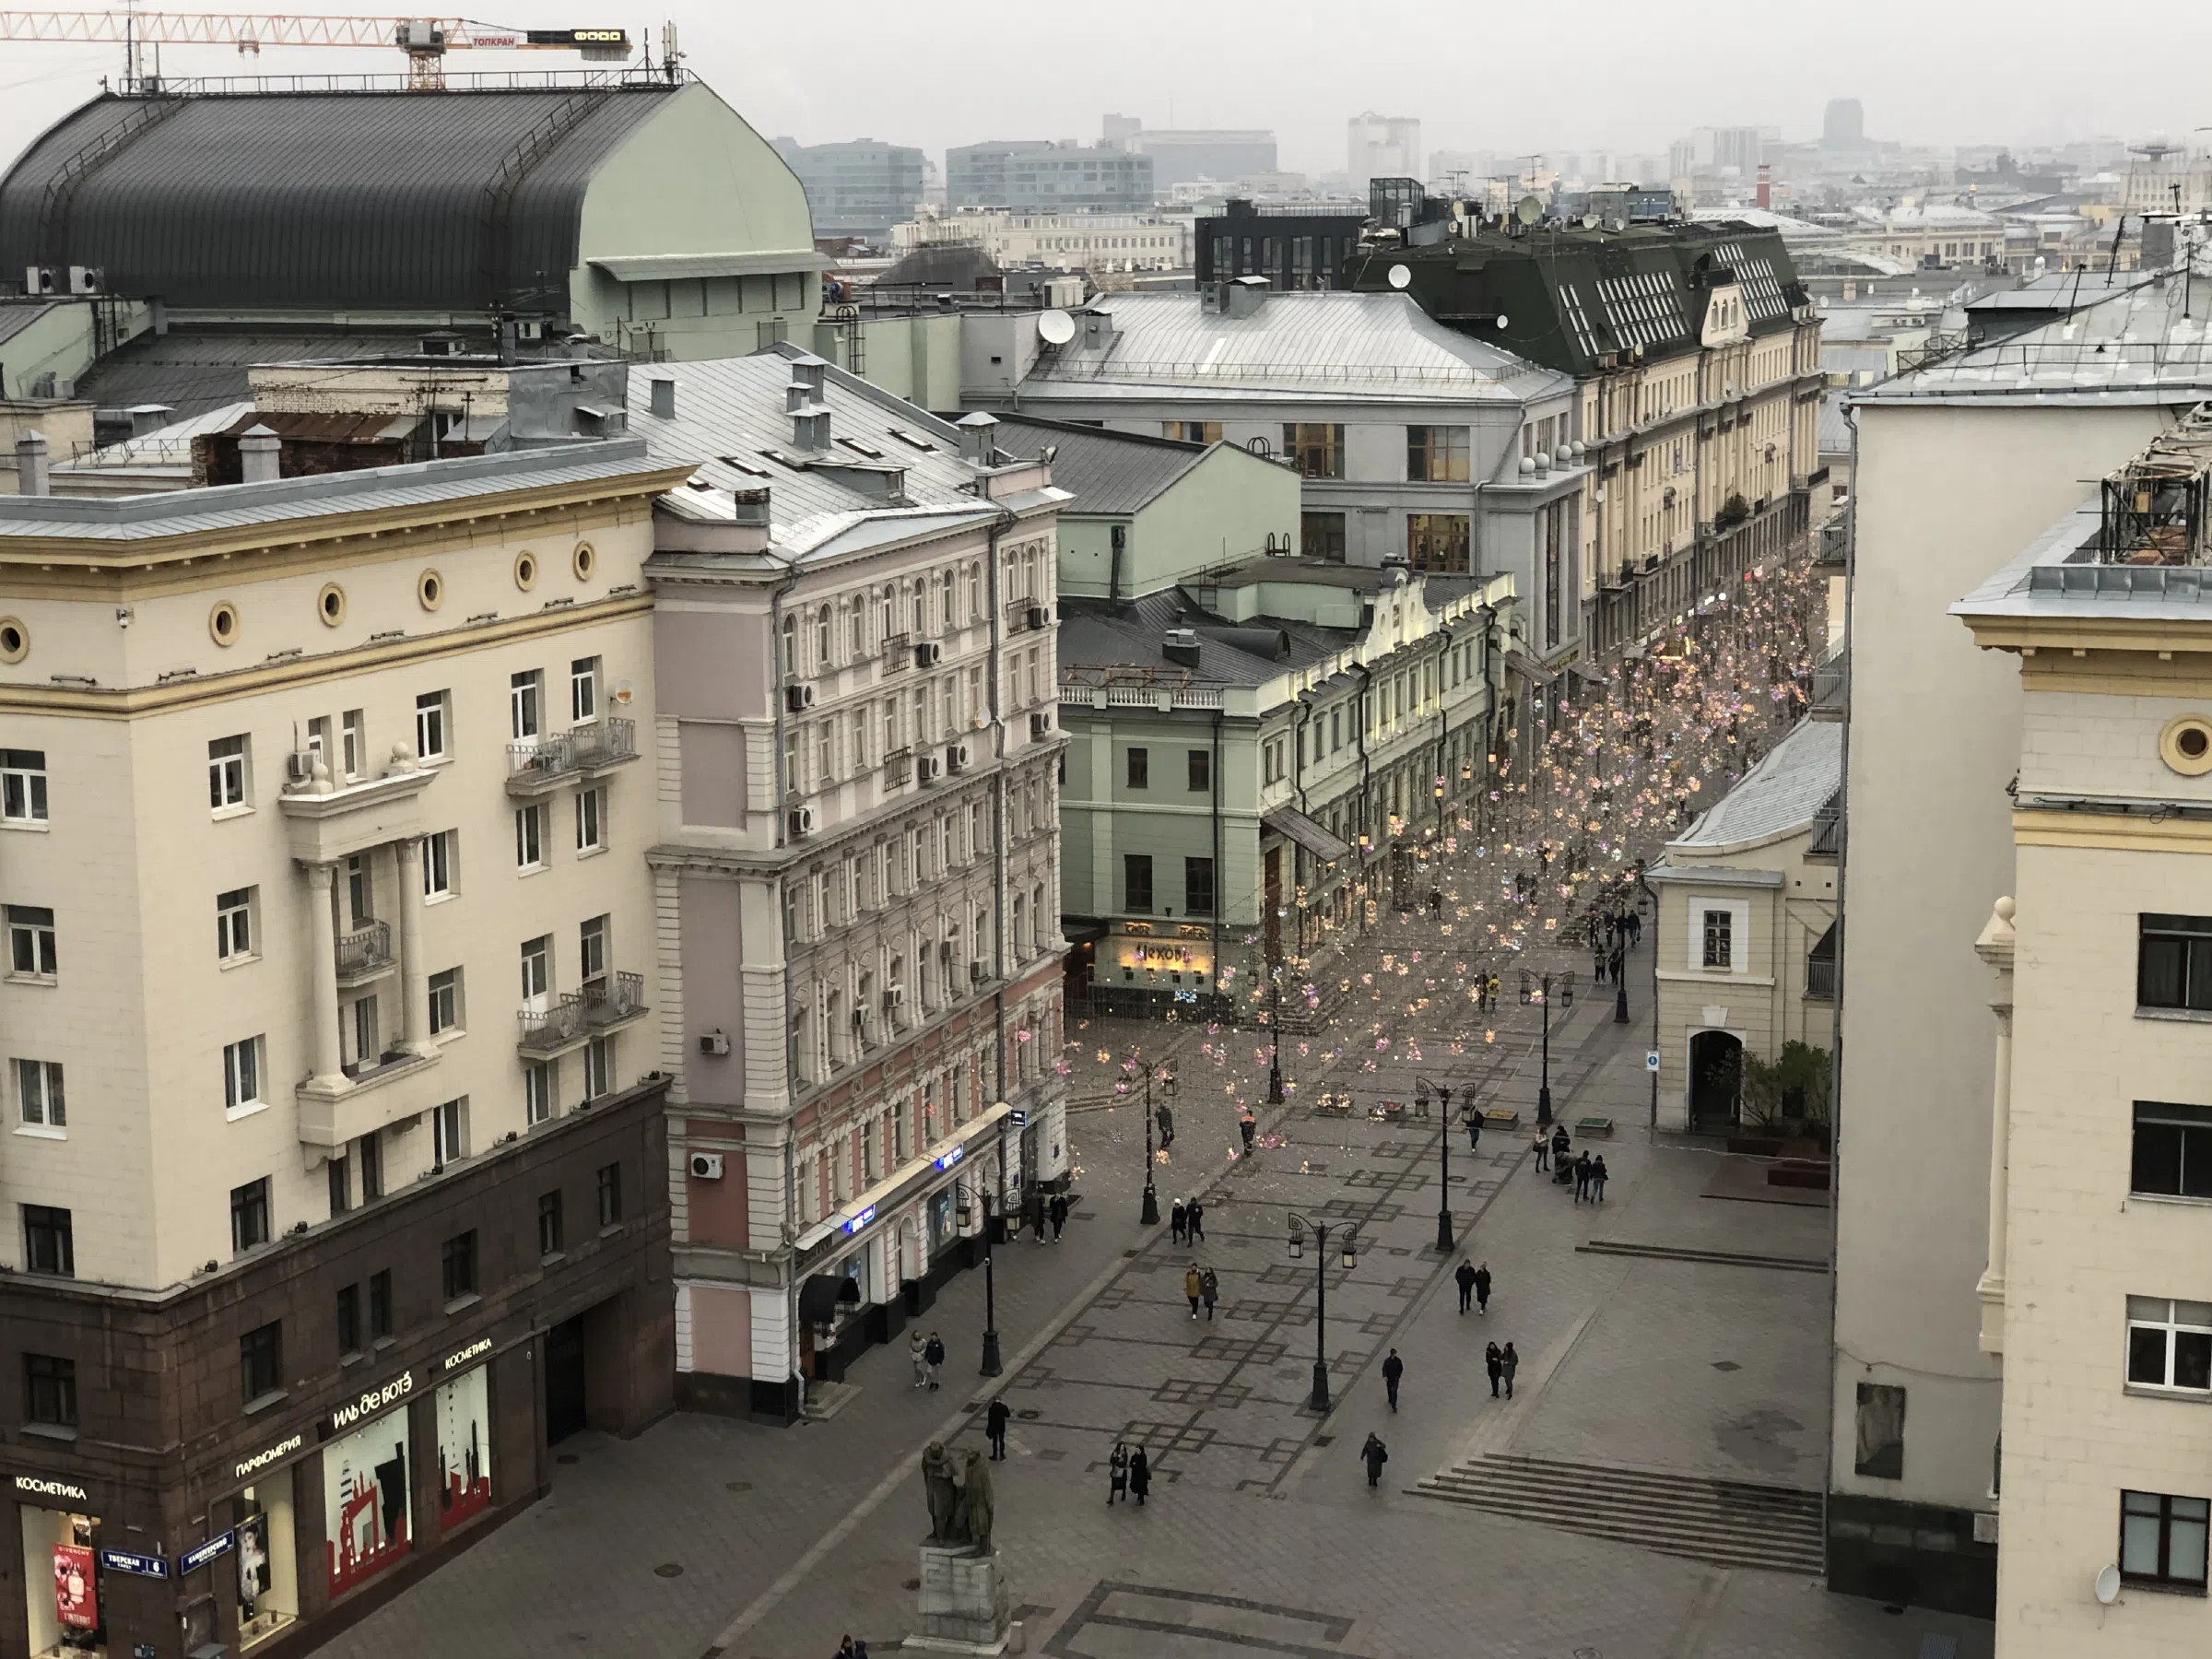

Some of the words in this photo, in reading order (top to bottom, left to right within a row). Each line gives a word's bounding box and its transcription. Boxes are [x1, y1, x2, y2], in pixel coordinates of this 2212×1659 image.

[473, 37, 514, 47] ТОПКРАН
[445, 1338, 492, 1370] КОСМЕТИКА
[333, 1406, 359, 1429] ИЛЬ
[360, 1393, 382, 1415] де
[236, 1435, 301, 1477] ПАРФЮМЕРИЯ
[16, 1477, 87, 1500] КОСМЕТИКА
[58, 1547, 89, 1556] GIVENCHY
[108, 1554, 140, 1567] ТВЕРСКАЯ
[153, 1561, 159, 1572] 6
